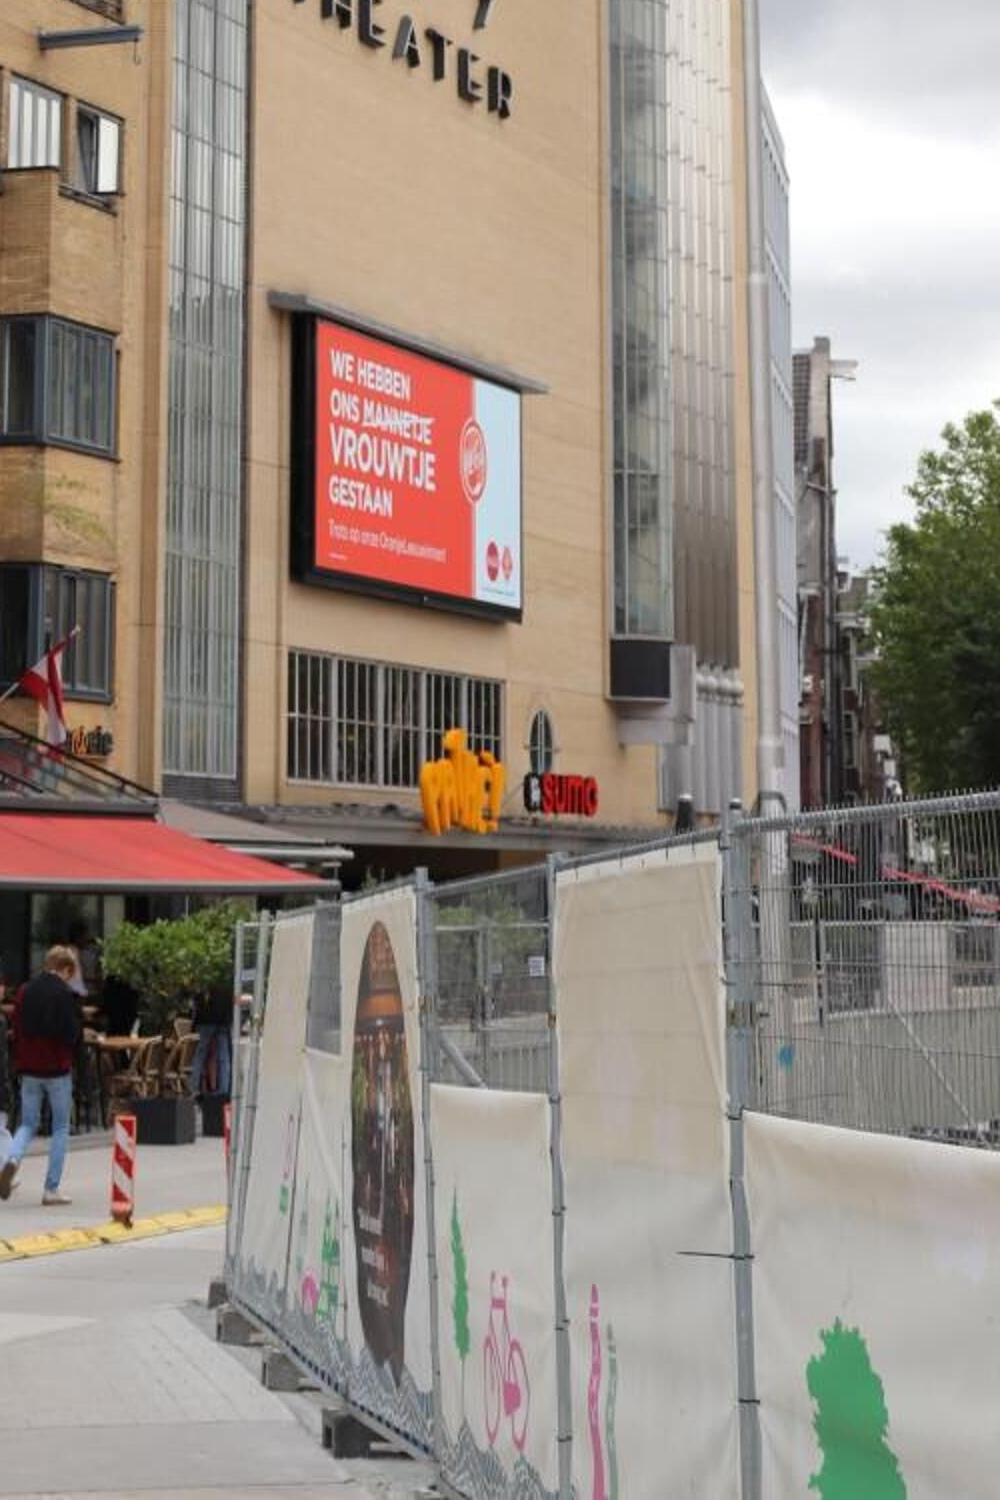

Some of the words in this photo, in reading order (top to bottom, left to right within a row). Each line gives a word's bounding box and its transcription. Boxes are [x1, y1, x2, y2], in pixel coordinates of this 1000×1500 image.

[330, 348, 354, 384] WE
[357, 357, 411, 401] HEBBEN
[330, 388, 360, 424] ONS
[329, 422, 436, 492] VROUWTJE
[328, 476, 393, 518] GESTAAN
